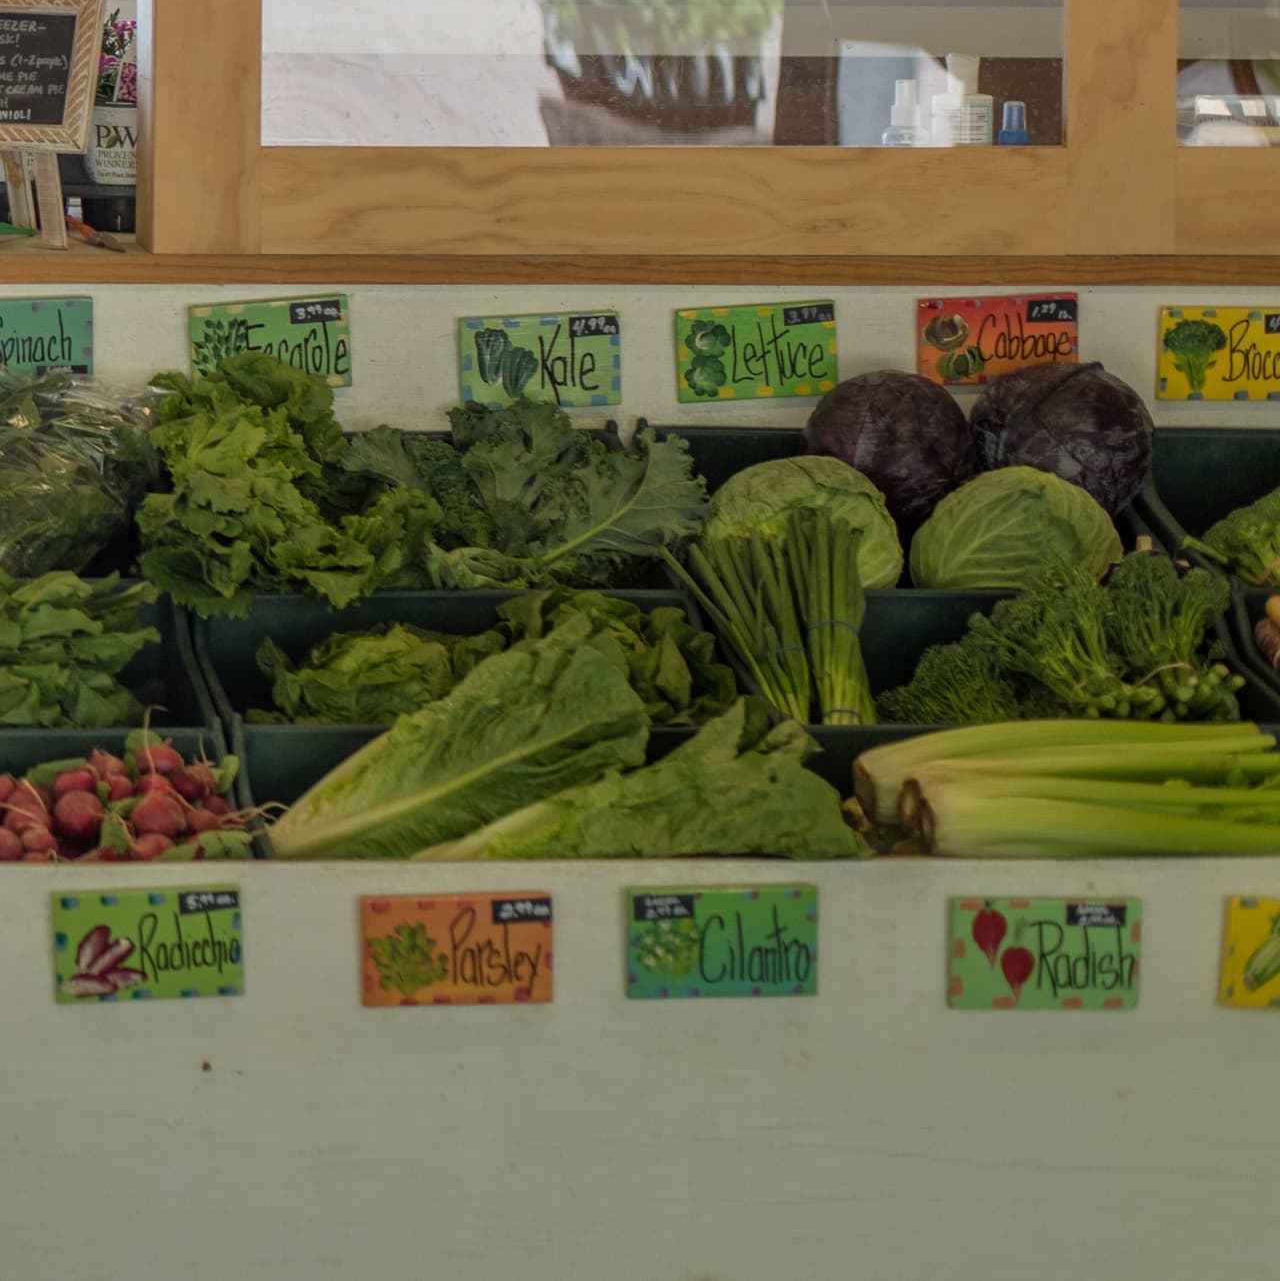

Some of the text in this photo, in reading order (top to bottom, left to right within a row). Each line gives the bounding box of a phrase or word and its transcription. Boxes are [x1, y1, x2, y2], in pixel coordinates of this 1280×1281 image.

[17, 71, 39, 82] PIE
[47, 84, 65, 95] PIE
[538, 324, 599, 405] Kale
[729, 312, 828, 387] Lettuce
[976, 314, 1072, 362] Cabbage
[138, 906, 240, 984] Radicchio
[448, 907, 542, 996] Parsley
[697, 904, 812, 984] Cilantro
[1029, 920, 1138, 998] Radish
